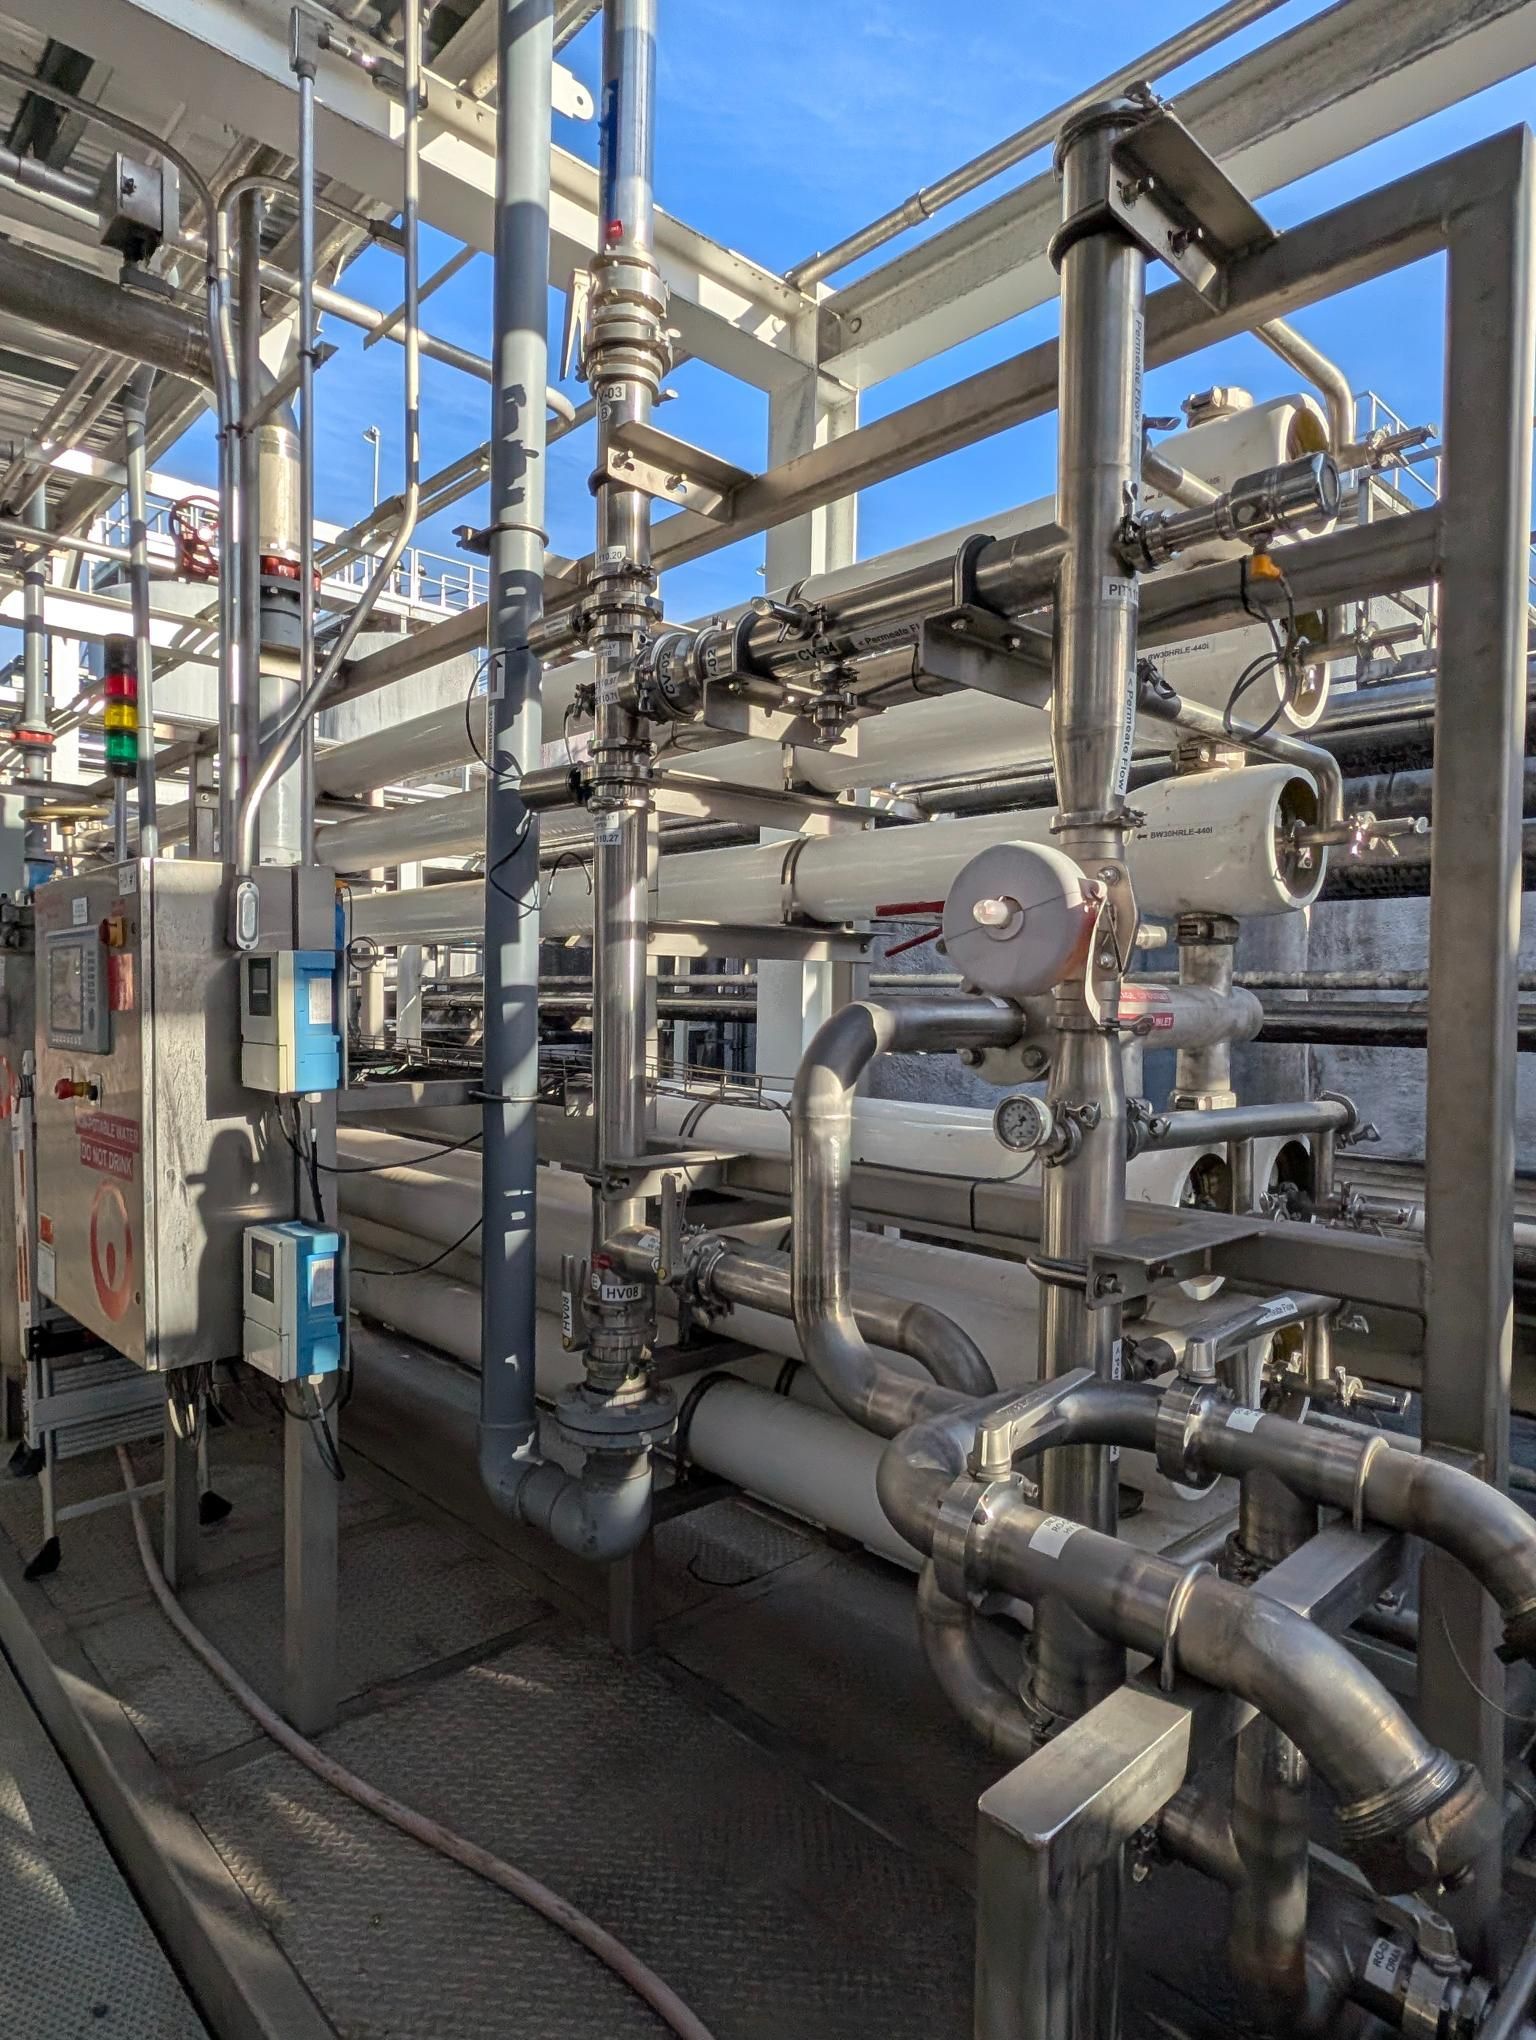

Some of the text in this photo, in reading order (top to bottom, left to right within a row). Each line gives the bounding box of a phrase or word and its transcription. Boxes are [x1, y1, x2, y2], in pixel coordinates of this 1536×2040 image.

[1134, 319, 1142, 385] Permeate
[1134, 388, 1142, 420] Flow
[661, 651, 676, 694] CV-02
[1122, 689, 1134, 754] Permeate
[1118, 757, 1129, 791] Flow
[81, 1142, 132, 1177] DO NOT DRINK
[606, 1286, 639, 1299] HV08
[562, 1296, 571, 1332] HV08
